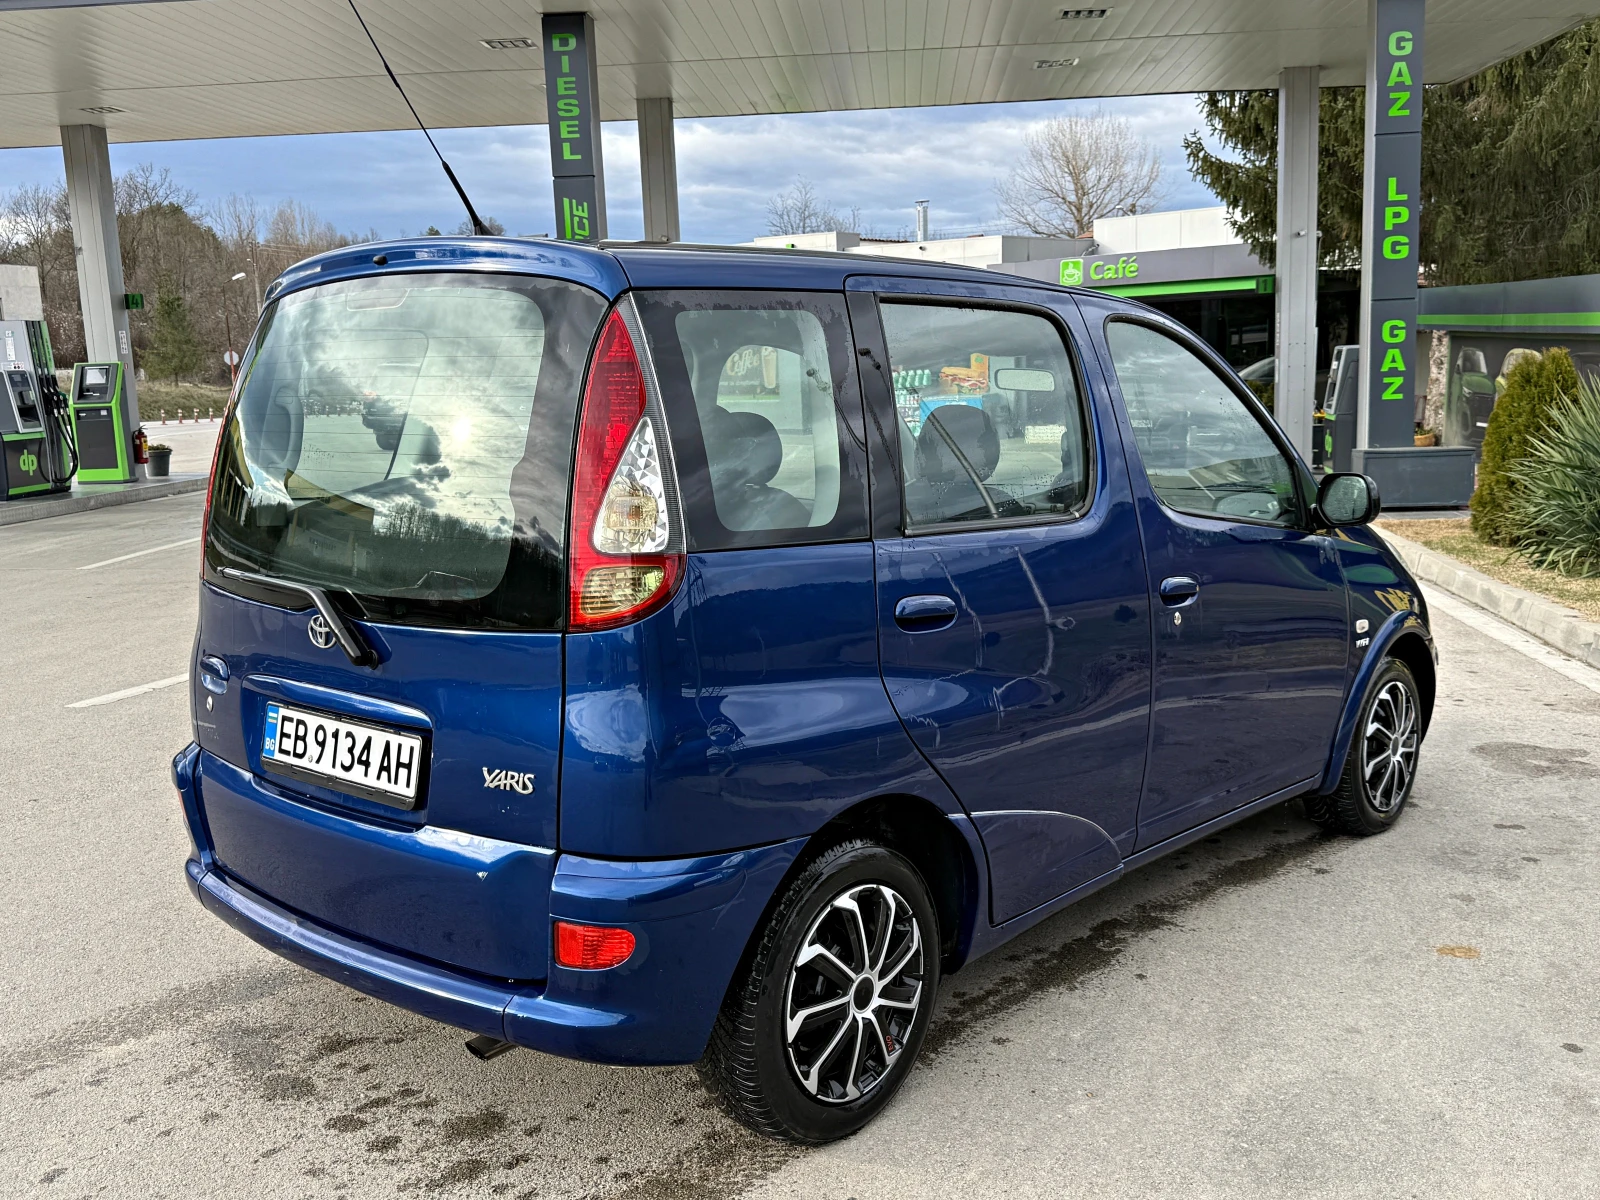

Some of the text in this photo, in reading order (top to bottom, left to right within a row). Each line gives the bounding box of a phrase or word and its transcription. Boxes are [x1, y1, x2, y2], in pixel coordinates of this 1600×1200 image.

[1386, 31, 1413, 117] GAZ
[552, 33, 582, 160] DIESEL
[1382, 177, 1410, 260] LPG
[1089, 256, 1139, 280] Café
[131, 295, 140, 308] 4
[726, 349, 760, 376] Coffee
[1380, 319, 1407, 400] GAZ
[265, 737, 275, 751] BG
[482, 766, 536, 795] YARIS
